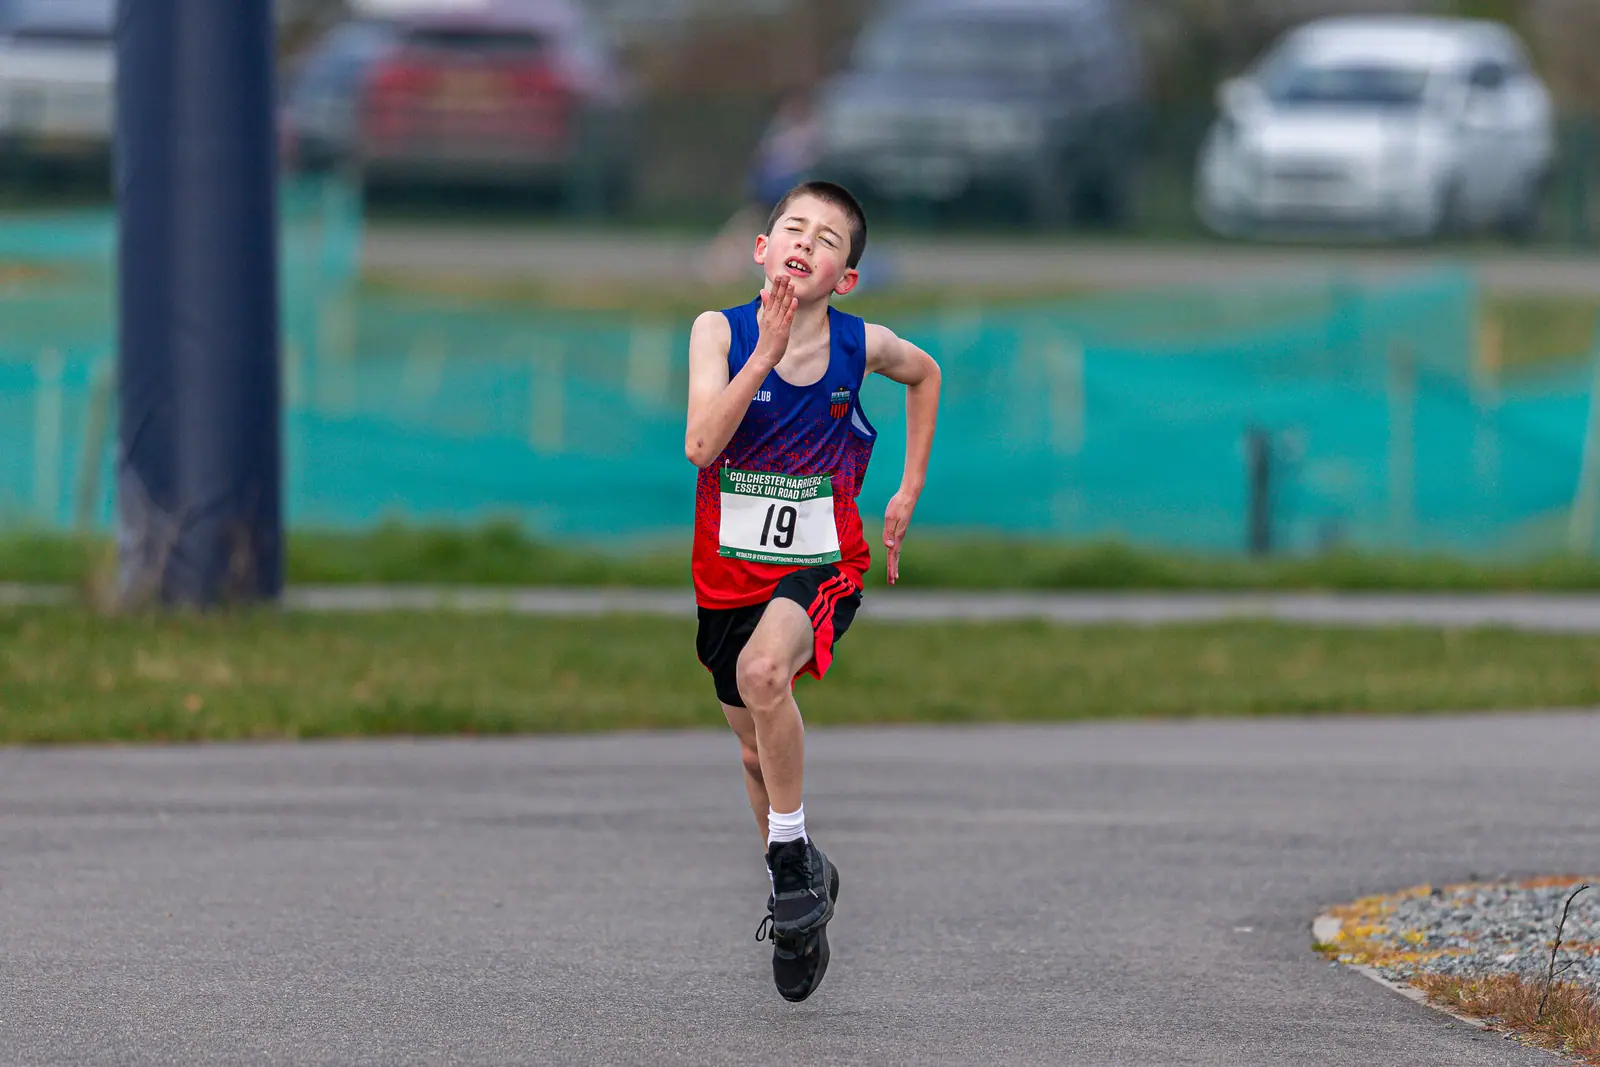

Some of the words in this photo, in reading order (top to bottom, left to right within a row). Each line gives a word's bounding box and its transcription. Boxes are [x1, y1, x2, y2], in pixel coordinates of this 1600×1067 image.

[730, 472, 786, 487] COLCHESTER
[786, 476, 823, 489] HARRIERS
[734, 482, 763, 495] ESSEX
[777, 487, 799, 500] ROAD
[800, 486, 818, 499] RACE
[759, 504, 797, 549] 19
[736, 551, 752, 559] RESULTS
